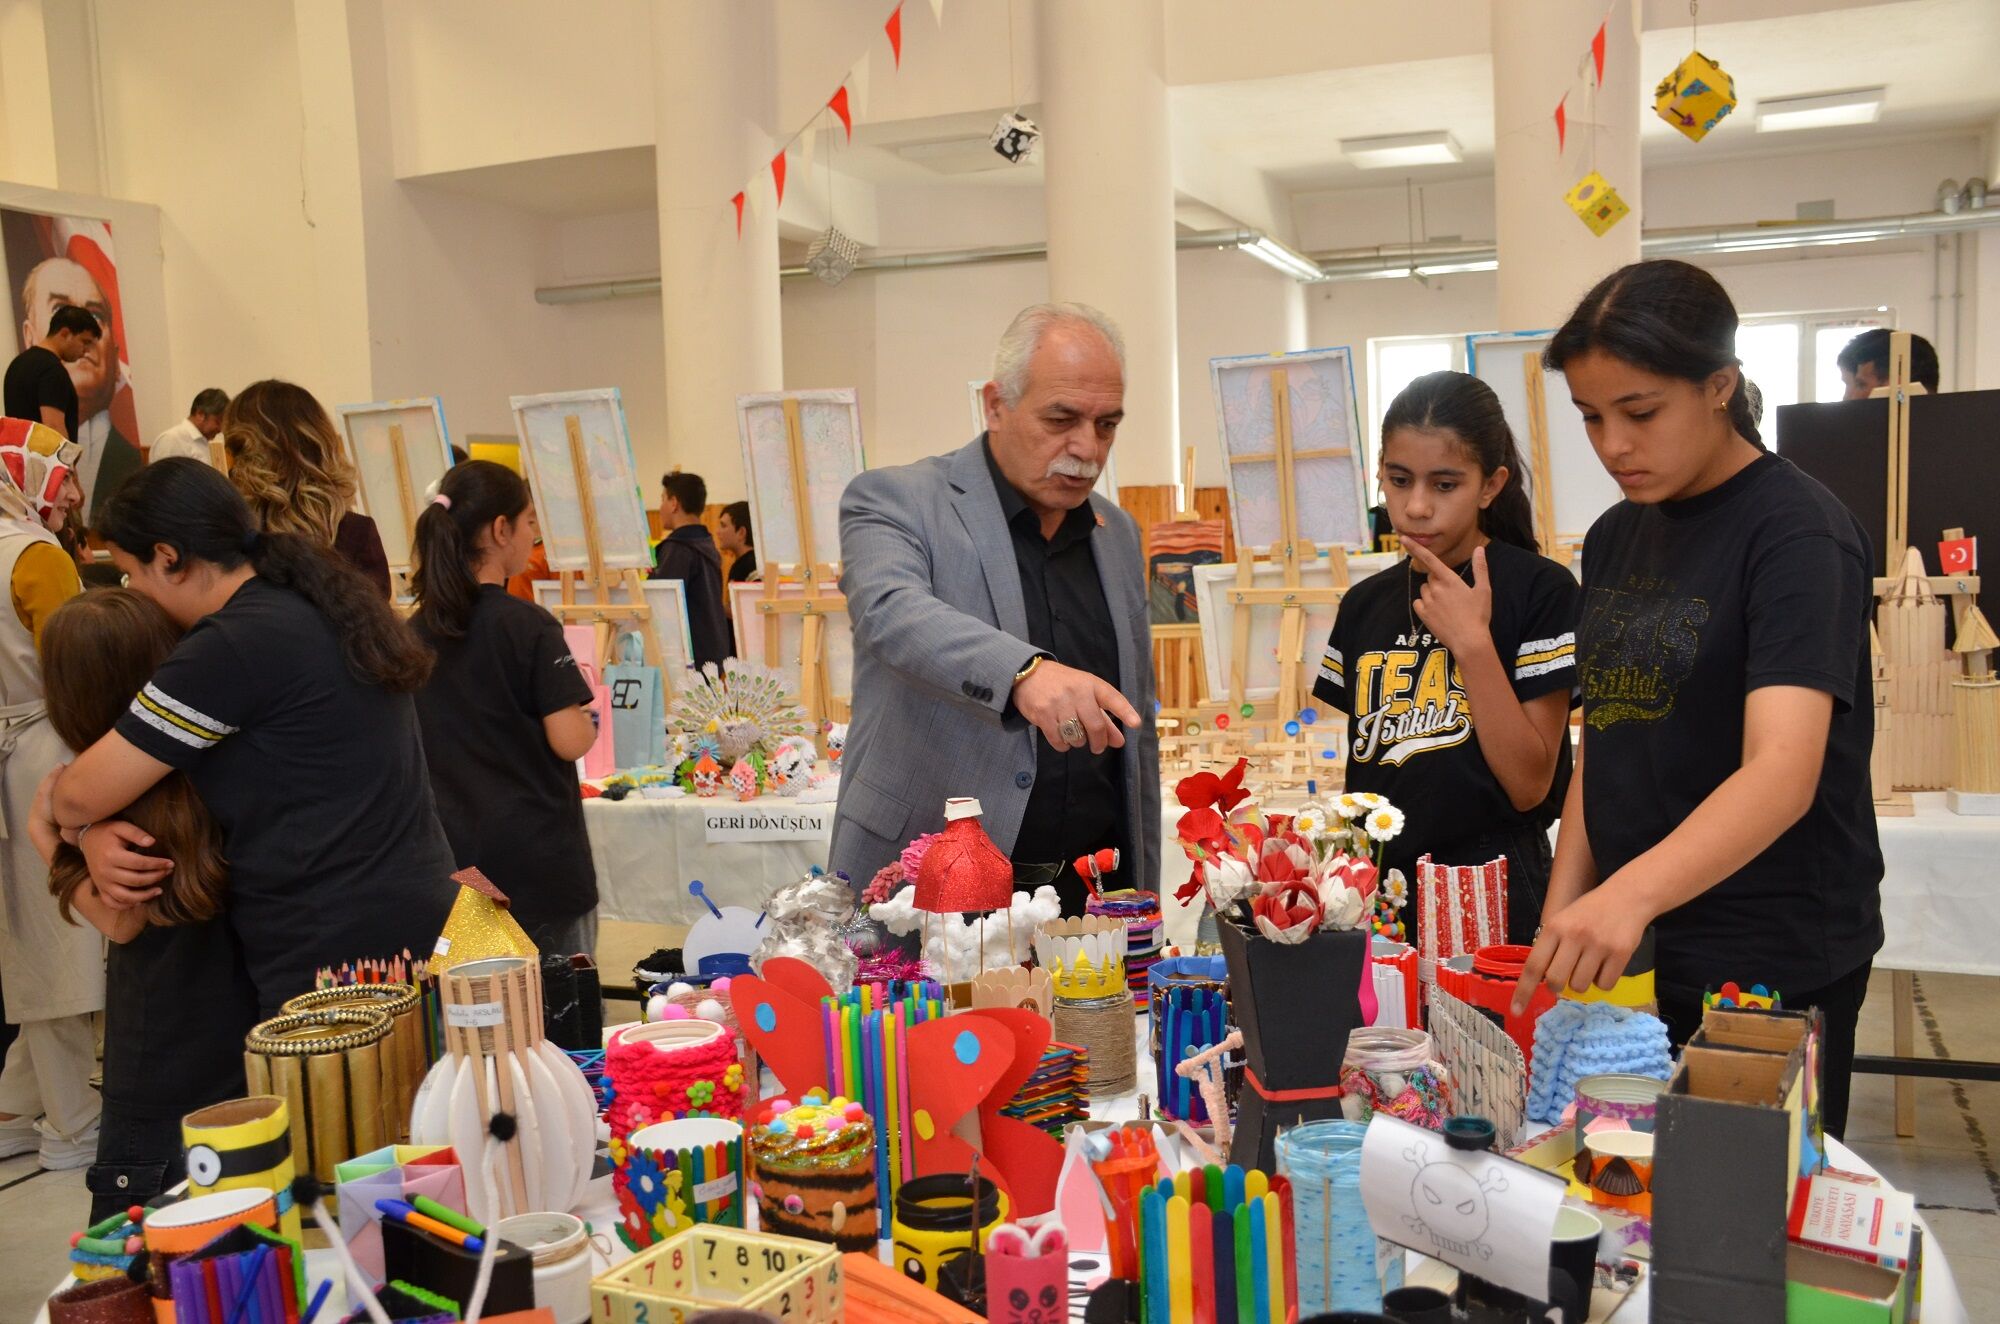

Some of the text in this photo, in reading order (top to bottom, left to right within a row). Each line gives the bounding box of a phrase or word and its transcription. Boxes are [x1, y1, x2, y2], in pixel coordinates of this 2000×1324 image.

[707, 814, 822, 833] GERİ DÖNÜŞÜM
[1838, 1192, 1857, 1241] ANAYASASI
[644, 1248, 683, 1285] 7 8
[703, 1238, 717, 1260] 7
[736, 1246, 749, 1267] 8
[762, 1248, 786, 1272] 10
[602, 1294, 611, 1317] 1
[780, 1262, 838, 1316] 2 3 4
